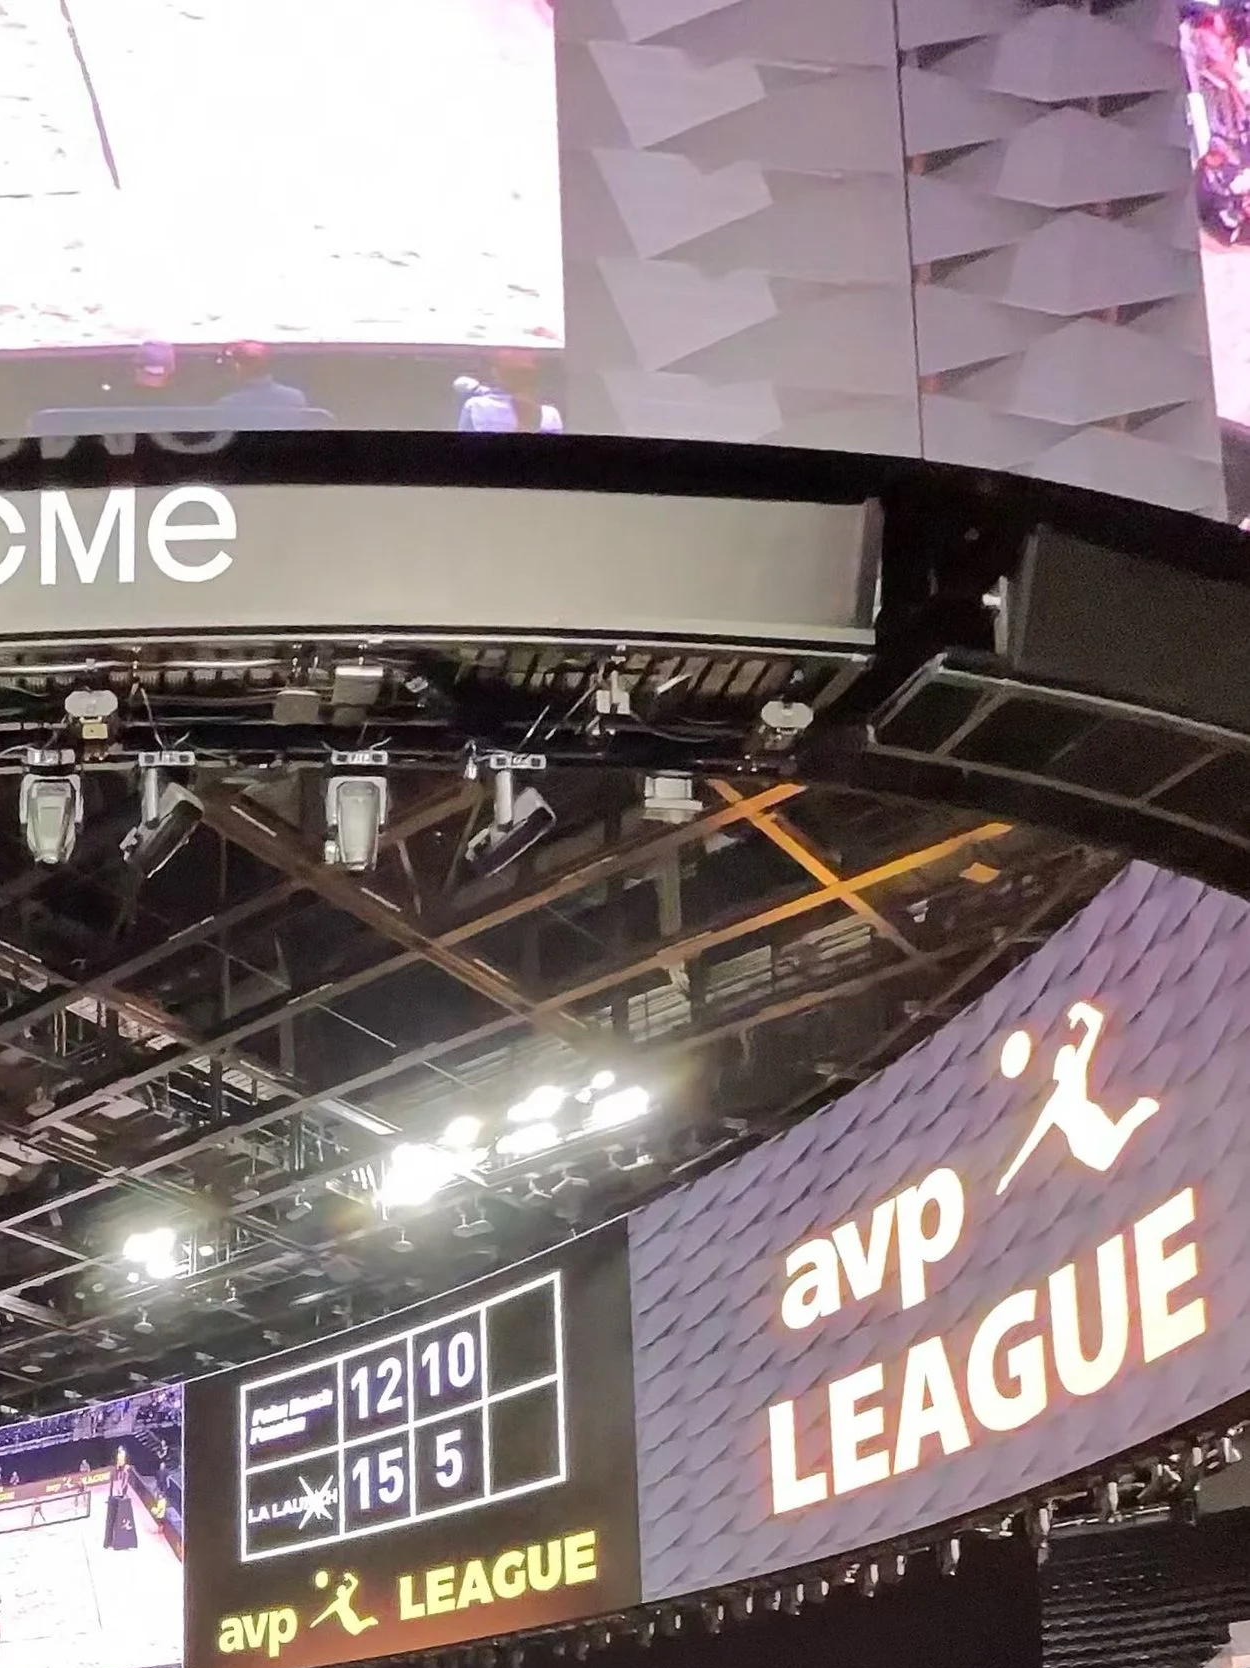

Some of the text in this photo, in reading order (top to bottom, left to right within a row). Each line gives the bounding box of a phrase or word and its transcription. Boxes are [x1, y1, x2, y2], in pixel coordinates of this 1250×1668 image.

[779, 1166, 965, 1331] avp
[350, 1331, 476, 1420] 12 10
[768, 1186, 1207, 1515] LEAGUE
[248, 1487, 338, 1524] LA LAUH
[352, 1428, 463, 1511] 15 5
[217, 1530, 597, 1658] avp LEAGUE
